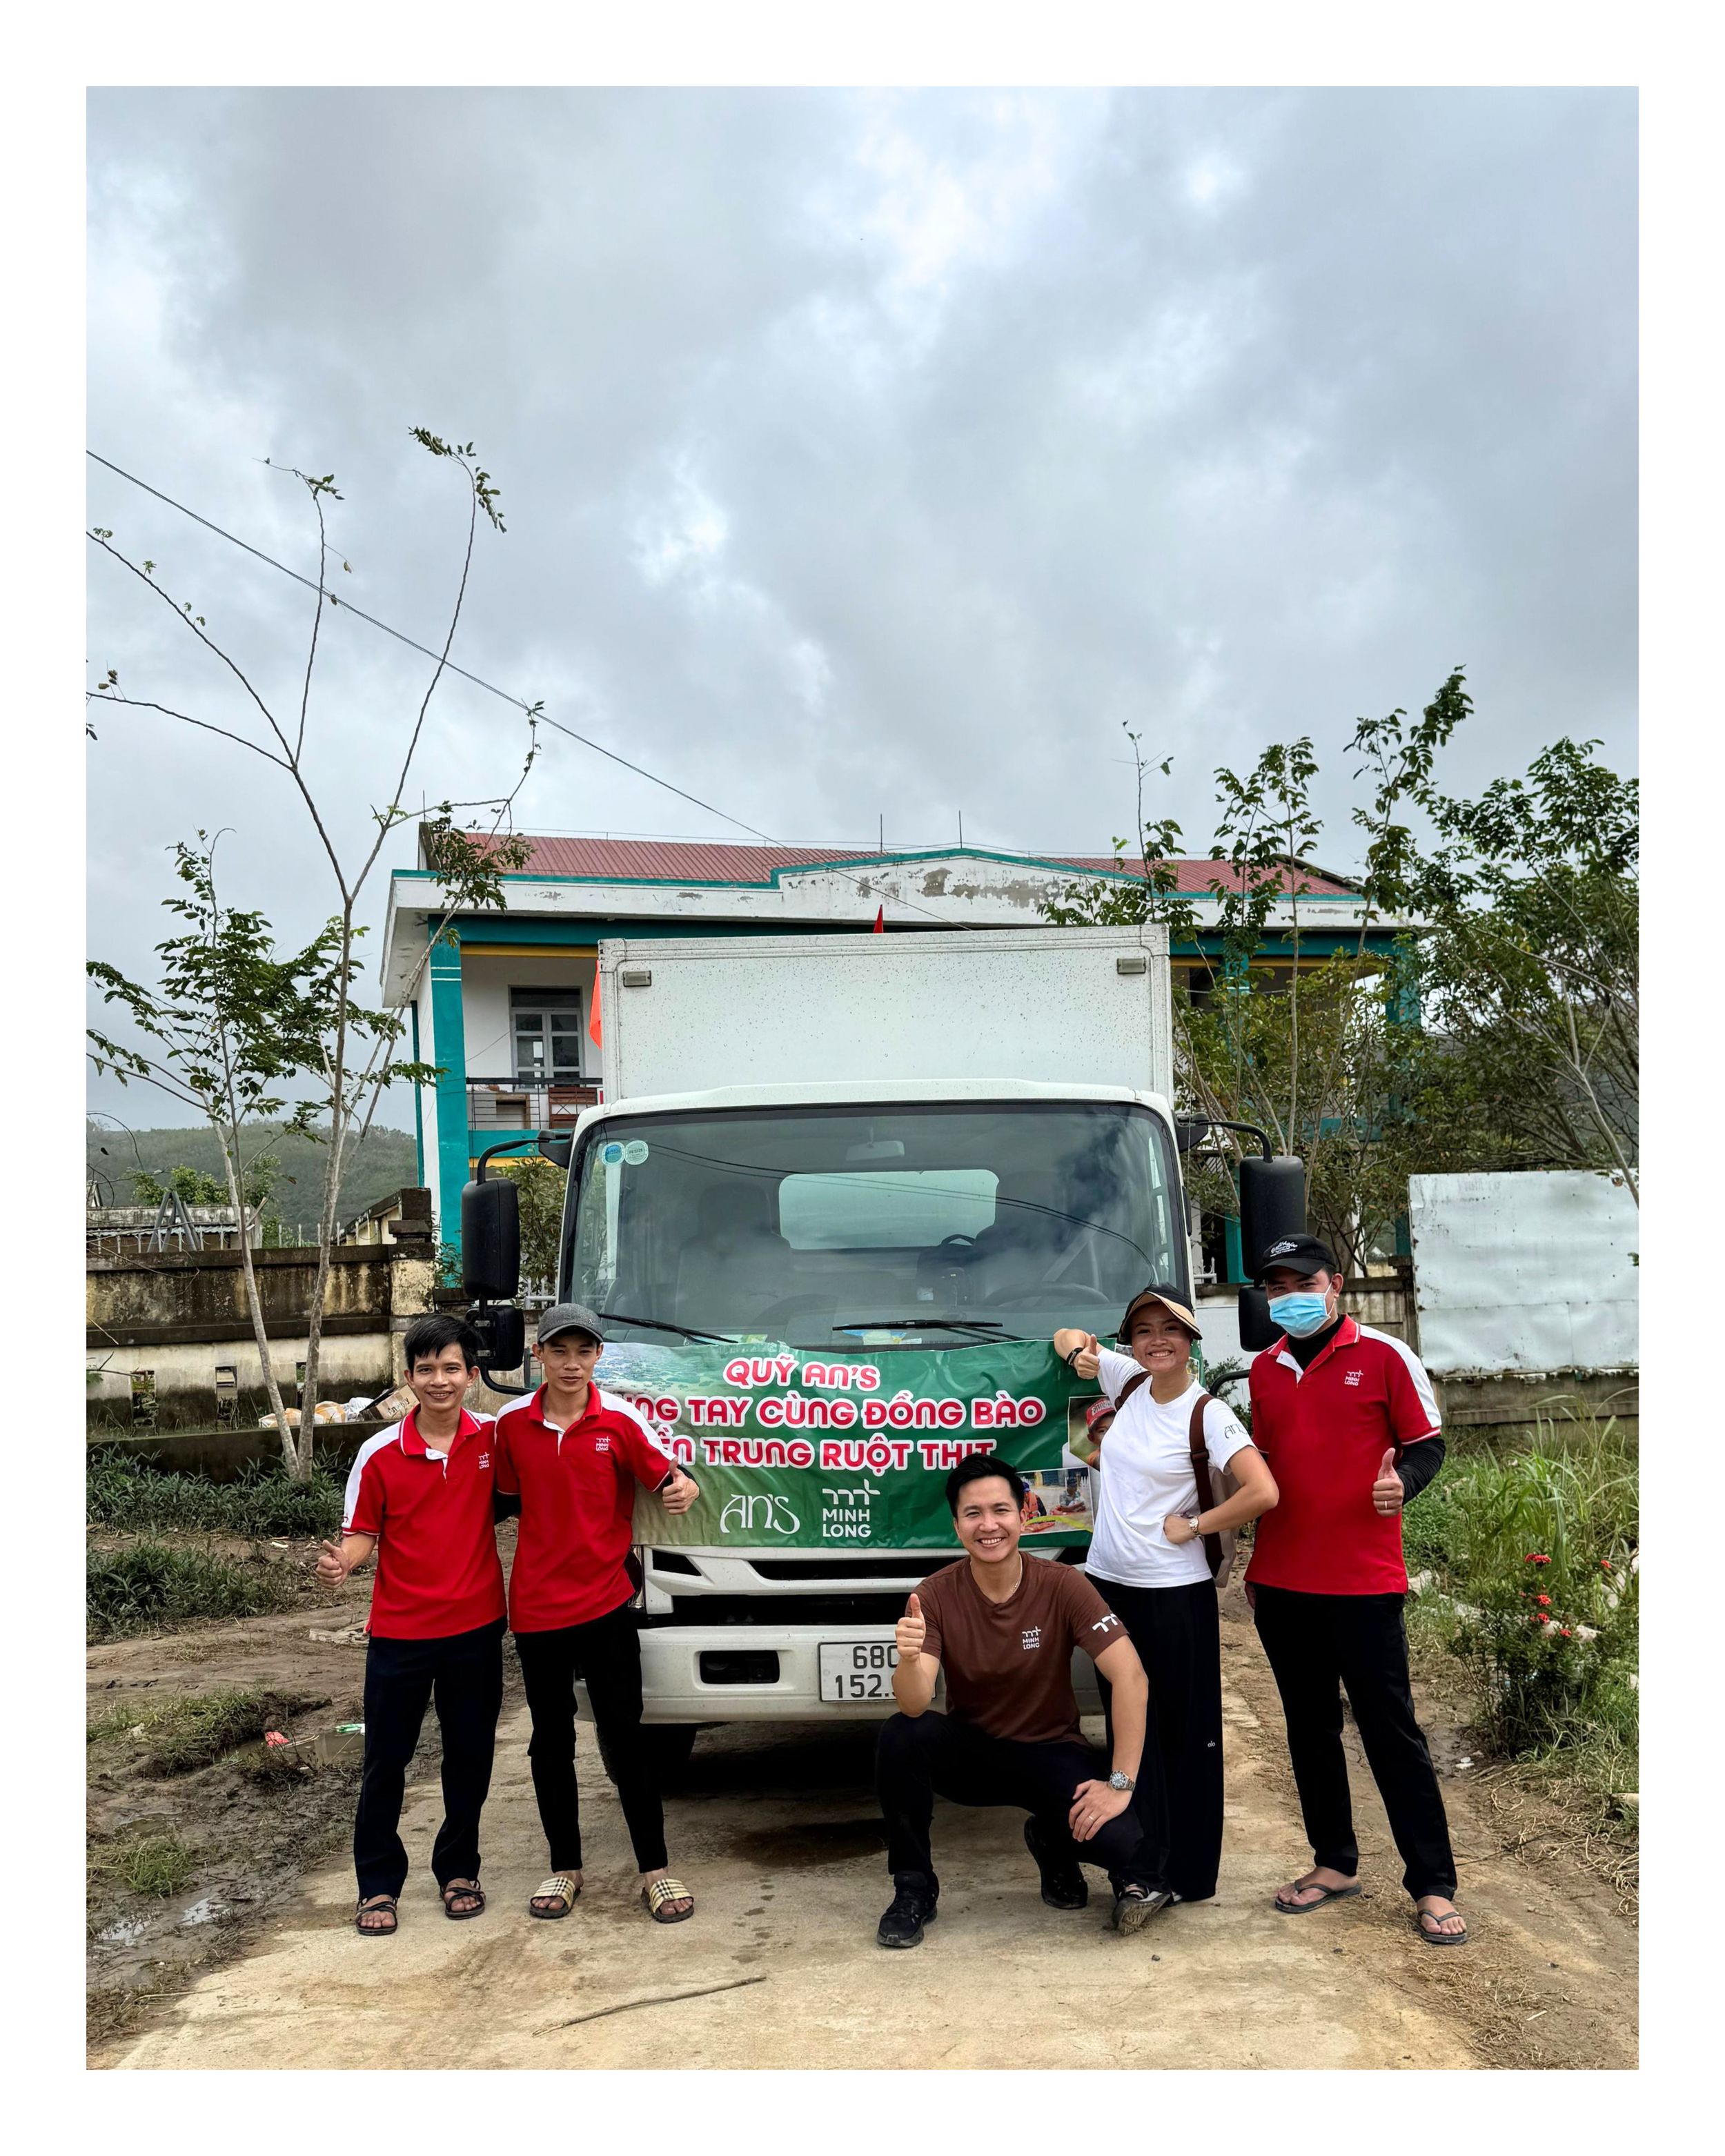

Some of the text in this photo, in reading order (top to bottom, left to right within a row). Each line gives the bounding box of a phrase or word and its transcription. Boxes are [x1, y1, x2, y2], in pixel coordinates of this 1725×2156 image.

[725, 1354, 796, 1387] QUỸ
[687, 1398, 750, 1424] TAY
[759, 1393, 855, 1426] CÙNG
[864, 1392, 963, 1426] ĐỒNG
[974, 1394, 1044, 1425] BÀO
[702, 1439, 812, 1467] TRUNG
[822, 1435, 911, 1474] RUỘT
[822, 1507, 871, 1523] MINH
[822, 1523, 872, 1539] LONG
[835, 1674, 896, 1699] 152.
